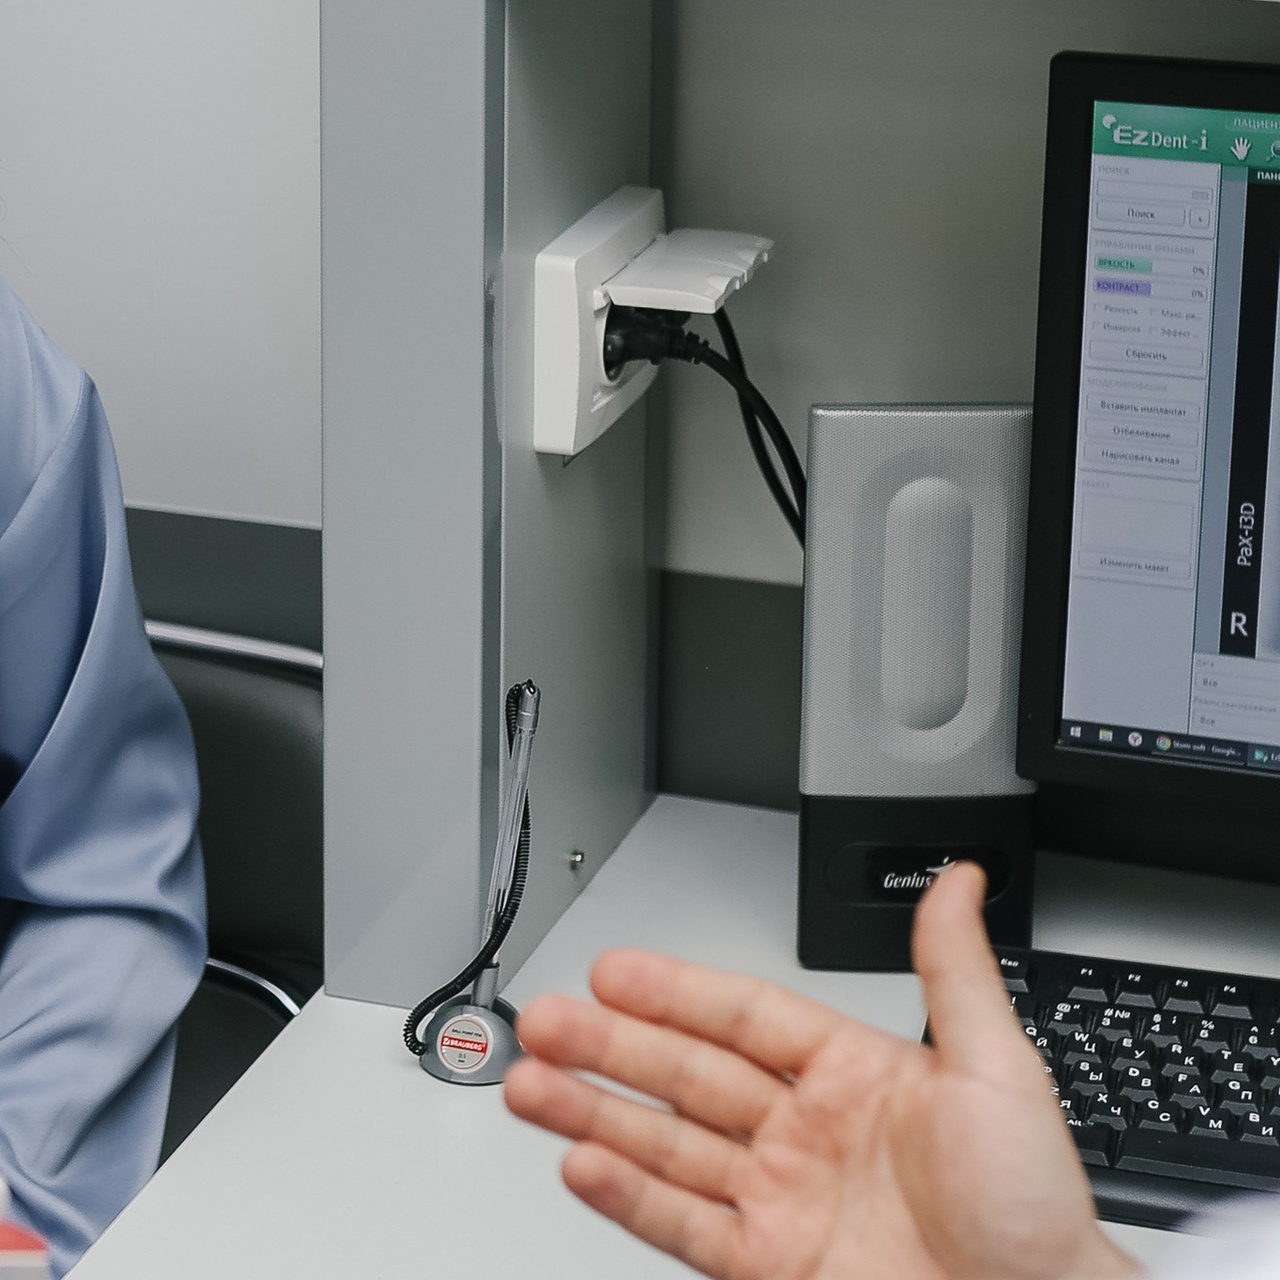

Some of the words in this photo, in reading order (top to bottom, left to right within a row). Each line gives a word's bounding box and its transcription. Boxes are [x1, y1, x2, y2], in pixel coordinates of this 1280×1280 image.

[1234, 118, 1280, 130] ПАЦИЕН
[1127, 208, 1155, 219] Поиск
[1237, 502, 1255, 567] PaX-i3D
[1230, 611, 1248, 636] R
[884, 872, 932, 888] Genius
[1054, 1012, 1064, 1021] 2
[1025, 1026, 1037, 1036] Q
[1151, 1023, 1160, 1032] 4
[1074, 1032, 1089, 1042] W
[1084, 1042, 1096, 1053] Ц
[1122, 1038, 1133, 1047] E
[1171, 1044, 1182, 1054] R
[1221, 1050, 1232, 1060] T
[1089, 1071, 1103, 1081] Ы
[1128, 1067, 1140, 1077] D
[1177, 1074, 1188, 1082] F
[1228, 1080, 1241, 1090] G
[1097, 1093, 1108, 1103] X
[1241, 1090, 1253, 1100] П
[1147, 1100, 1159, 1109] C
[1198, 1106, 1210, 1116] V
[1249, 1113, 1260, 1122] B
[1261, 1126, 1274, 1136] И
